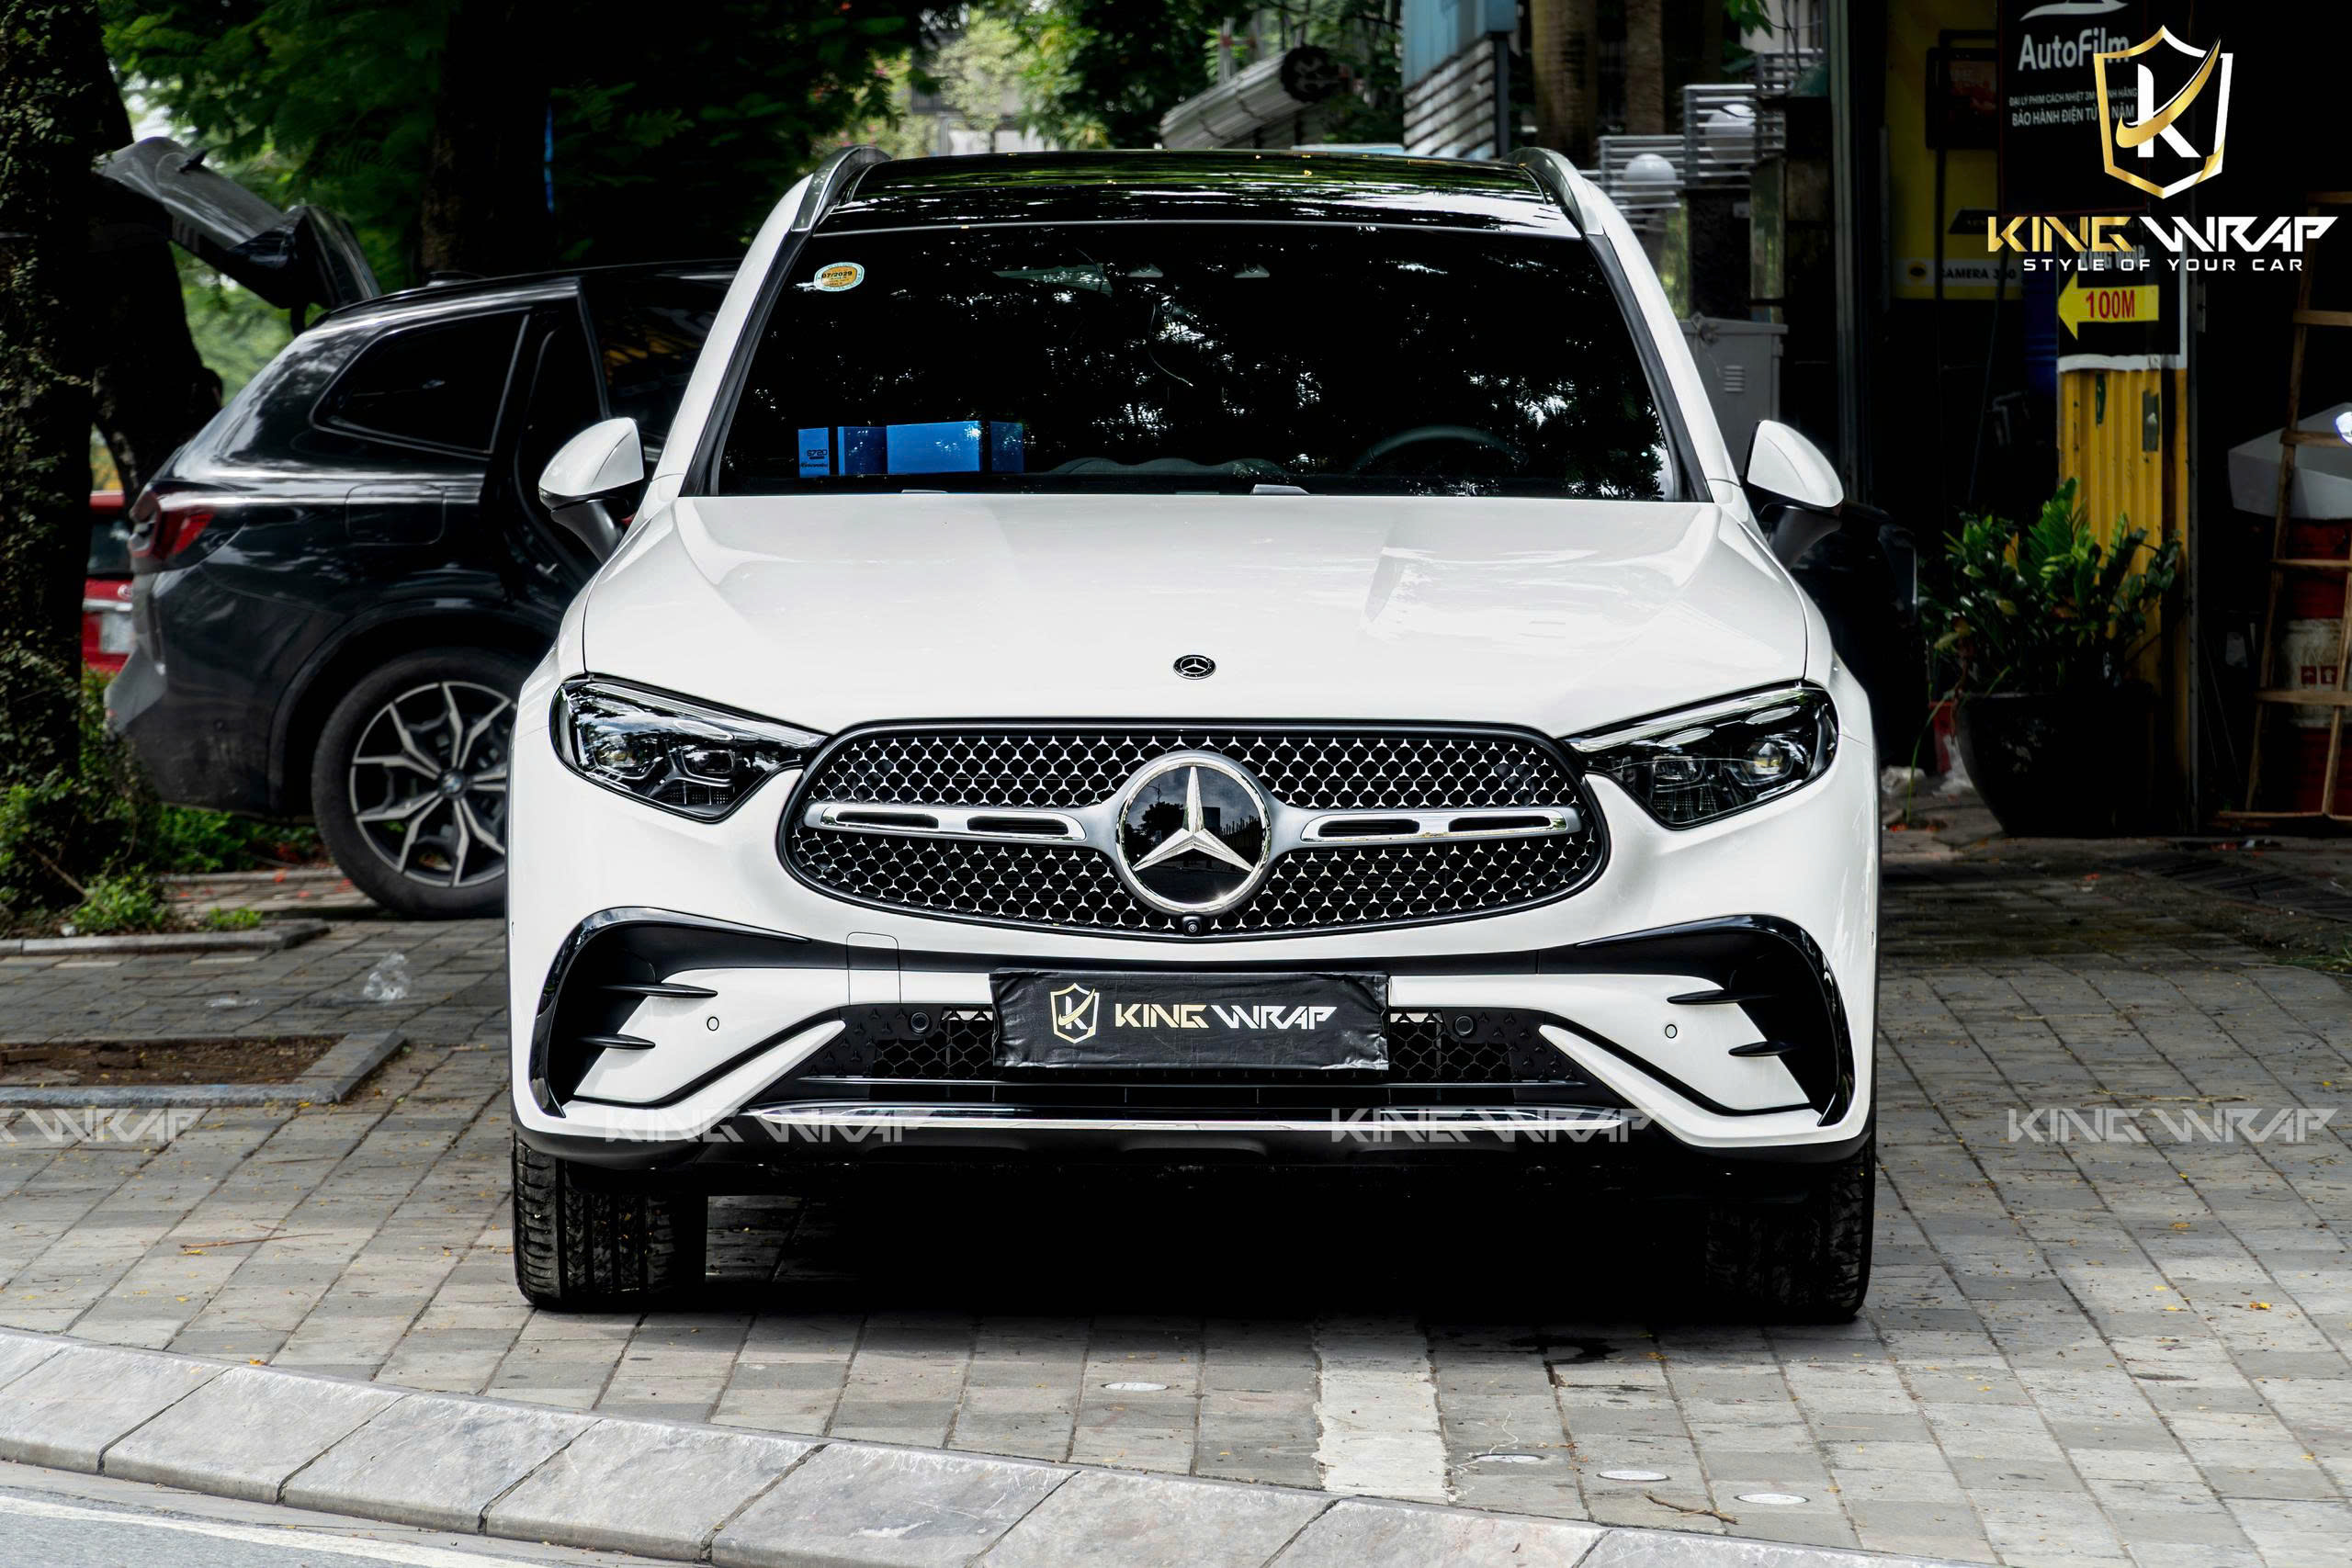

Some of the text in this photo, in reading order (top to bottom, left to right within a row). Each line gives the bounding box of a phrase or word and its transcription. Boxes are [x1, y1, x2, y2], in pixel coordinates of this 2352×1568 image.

[2018, 28, 2130, 71] AutoFilm
[2032, 107, 2060, 125] HÀNH
[2086, 288, 2136, 319] 100M
[1115, 1003, 1338, 1030] KING WRAP
